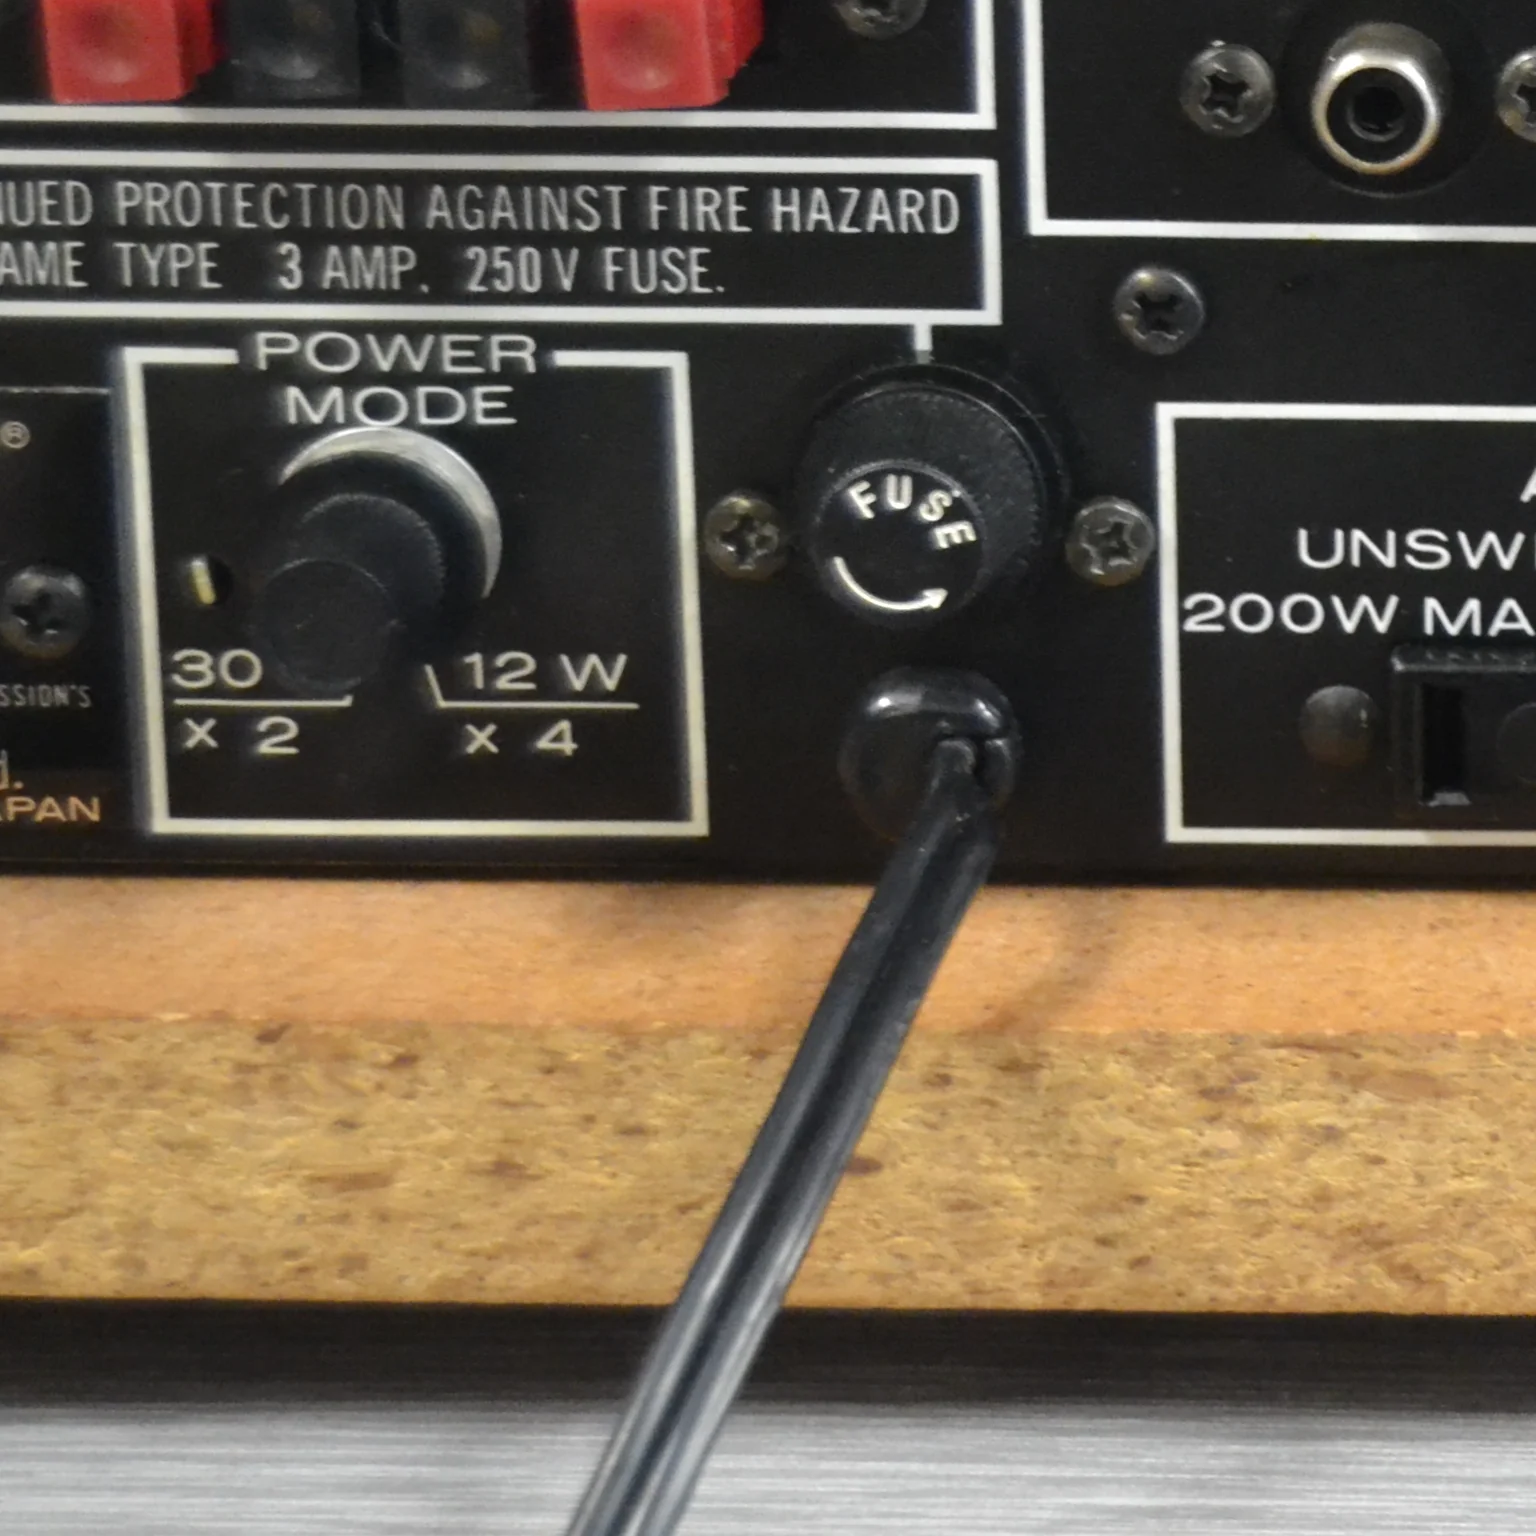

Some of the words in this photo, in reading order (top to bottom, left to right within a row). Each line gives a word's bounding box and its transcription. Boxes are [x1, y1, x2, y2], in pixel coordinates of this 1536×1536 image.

[0, 179, 93, 227] UED
[113, 180, 404, 230] PROTECTION
[425, 184, 627, 233] AGAINST
[648, 185, 753, 233] FIRE
[772, 187, 960, 235] HAZARD
[113, 241, 223, 289] TYPE
[277, 242, 303, 290] 3
[321, 244, 429, 293] AMP.
[603, 246, 725, 294] FUSE.
[254, 331, 537, 374] POWER
[284, 385, 517, 426] MODE
[848, 474, 977, 549] FUSE
[1182, 592, 1399, 634] 200W
[171, 648, 263, 689] 30
[463, 651, 537, 691] 12
[559, 653, 628, 692] W
[256, 715, 299, 755] 2
[534, 719, 578, 756] 4
[0, 795, 101, 822] PAN
